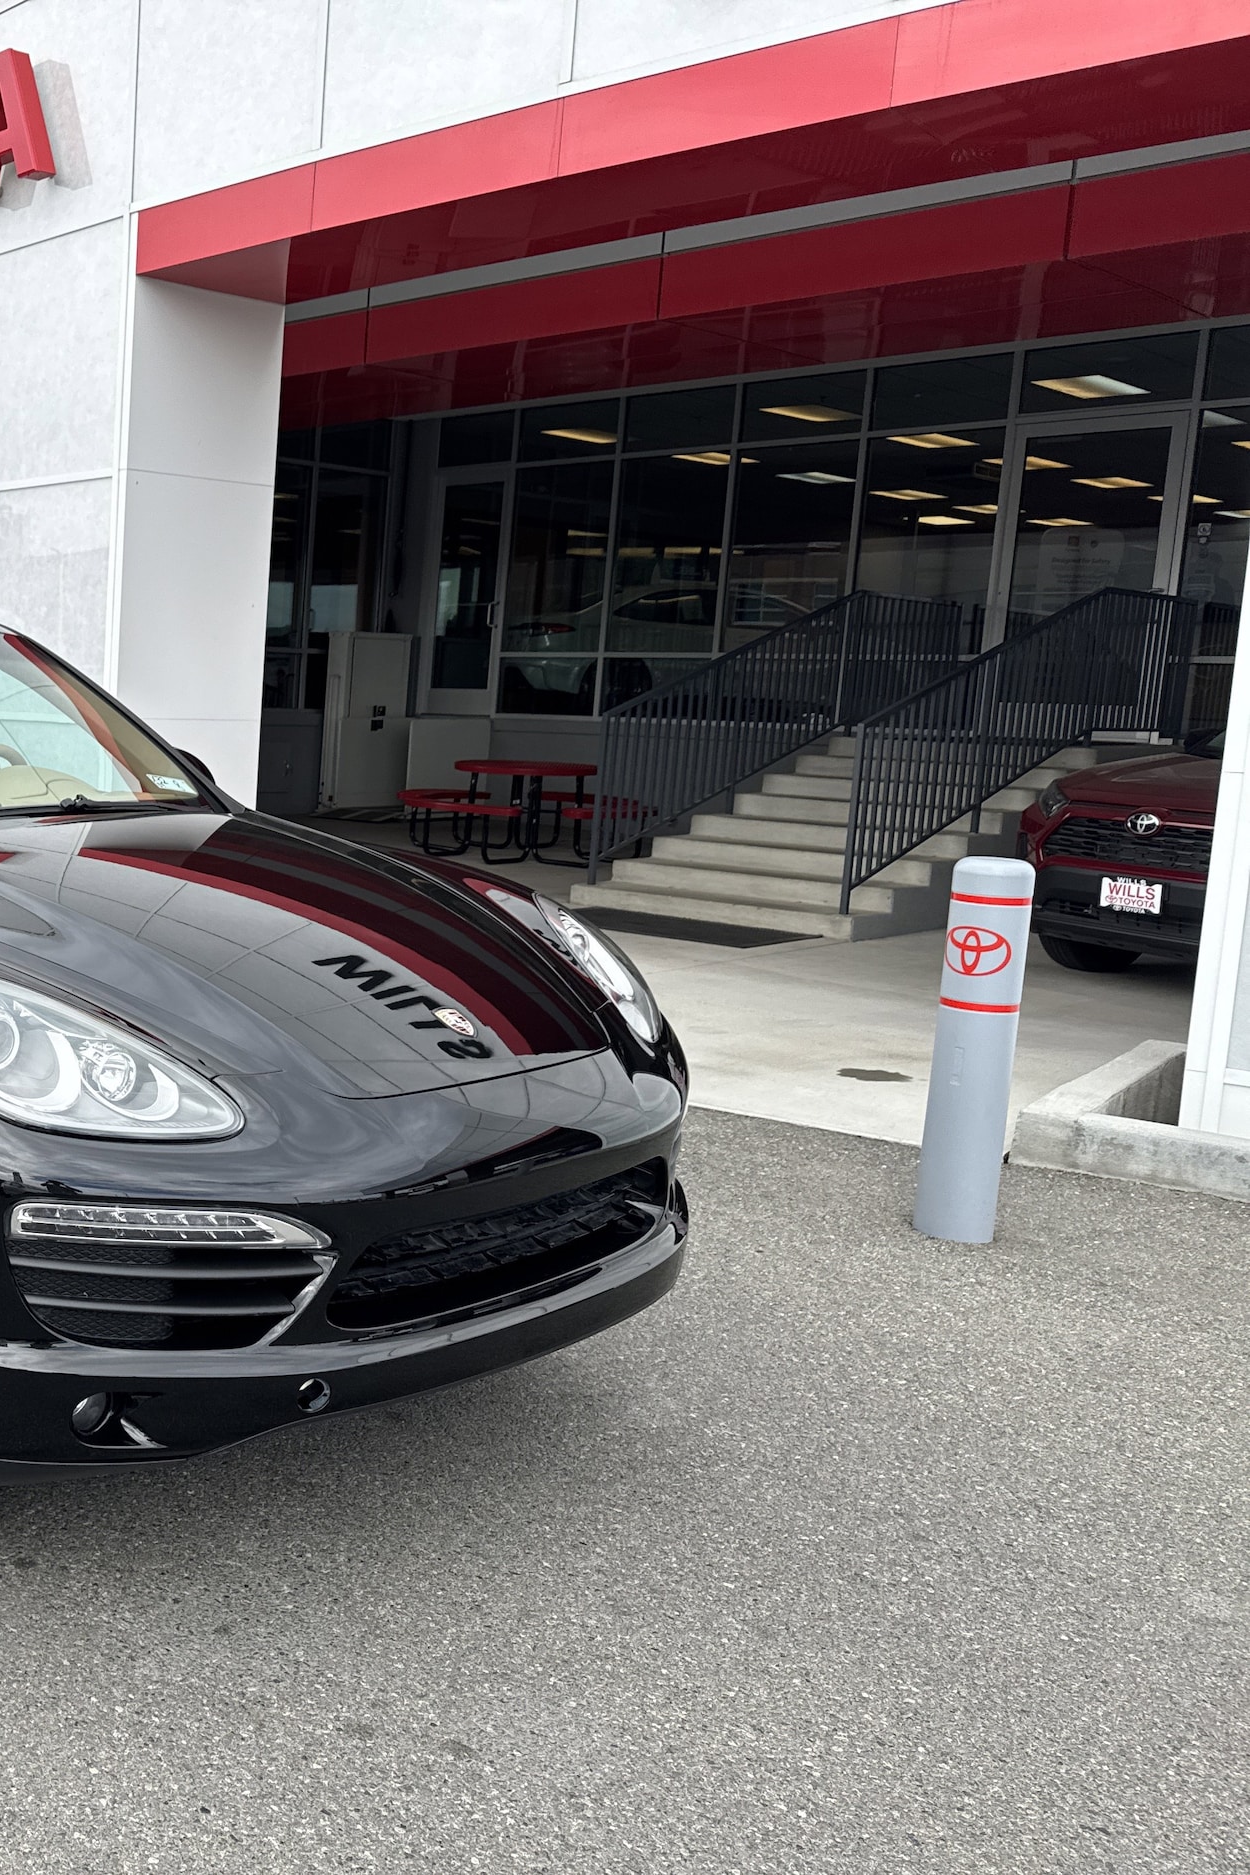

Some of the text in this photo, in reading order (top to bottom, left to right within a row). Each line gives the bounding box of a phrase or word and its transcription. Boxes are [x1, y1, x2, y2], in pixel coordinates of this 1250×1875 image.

[1117, 876, 1147, 886] WILLS
[1109, 882, 1155, 900] WILLS
[1118, 897, 1156, 909] TOYOTA
